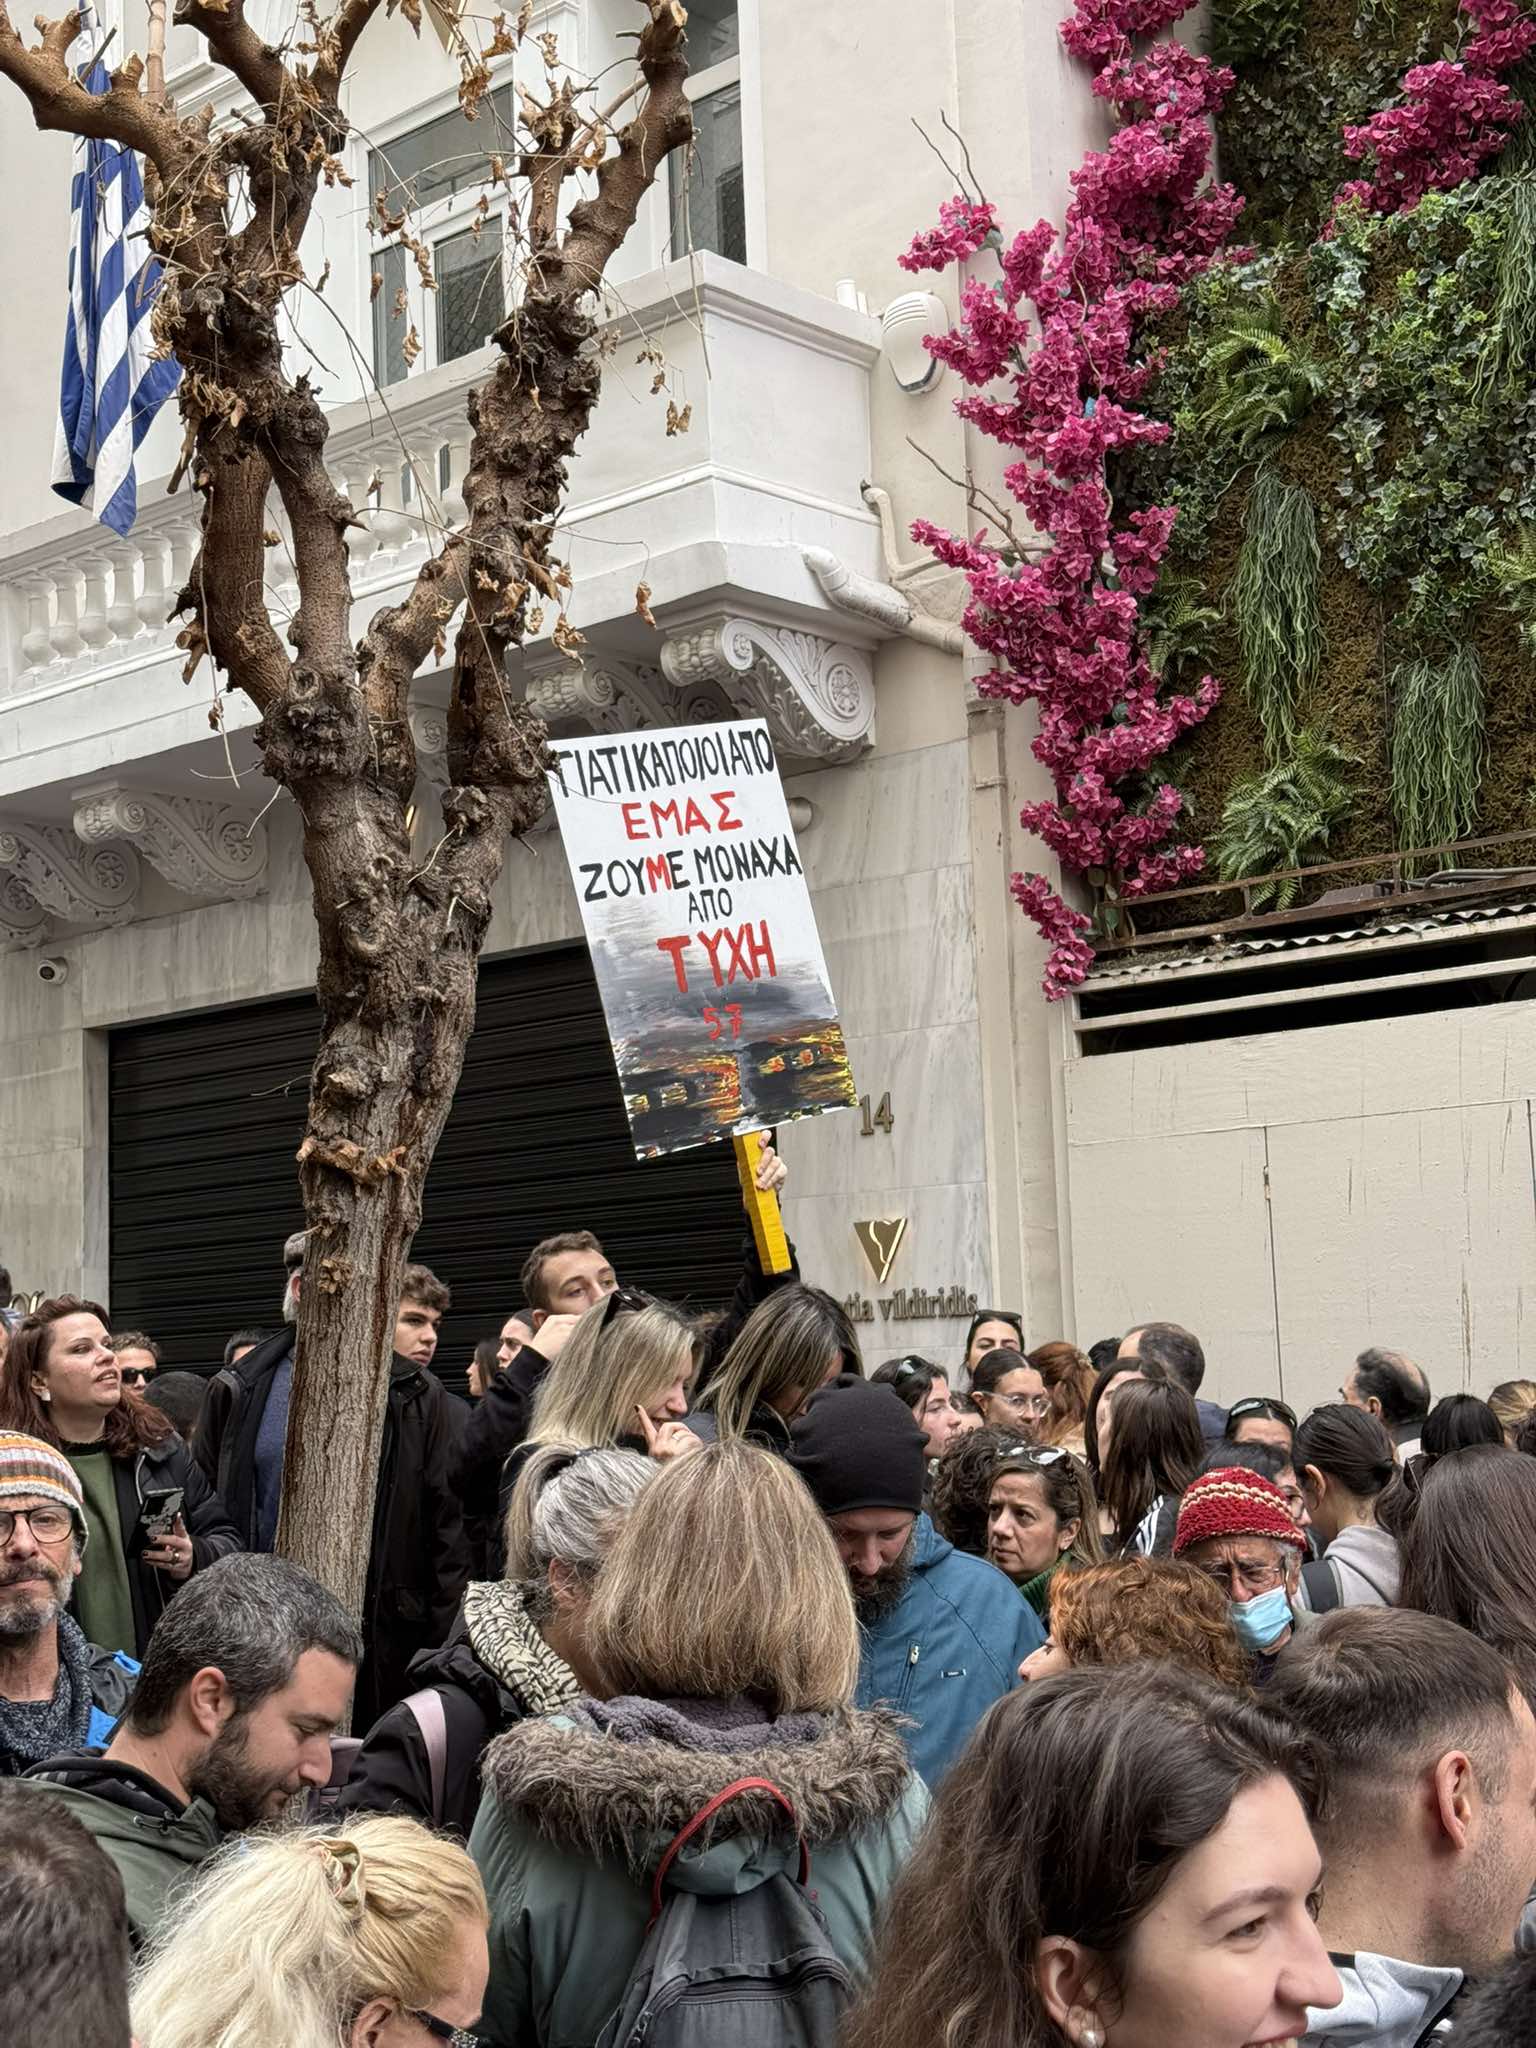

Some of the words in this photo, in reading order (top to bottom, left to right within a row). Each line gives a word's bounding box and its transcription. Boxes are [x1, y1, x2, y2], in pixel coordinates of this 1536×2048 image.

[557, 745, 636, 798] ΓΙΑΤΙ
[728, 728, 775, 776] ΑΠΟ
[621, 791, 743, 840] ΕΜΑΣ
[579, 850, 691, 902] ΖΟΥΜΕ
[693, 834, 803, 885] ΜΟΝΑΧΑ
[688, 887, 733, 923] ΑΠΟ
[656, 920, 777, 993] ΤΥΧΗ
[703, 1003, 743, 1040] 57
[859, 1091, 894, 1136] 14
